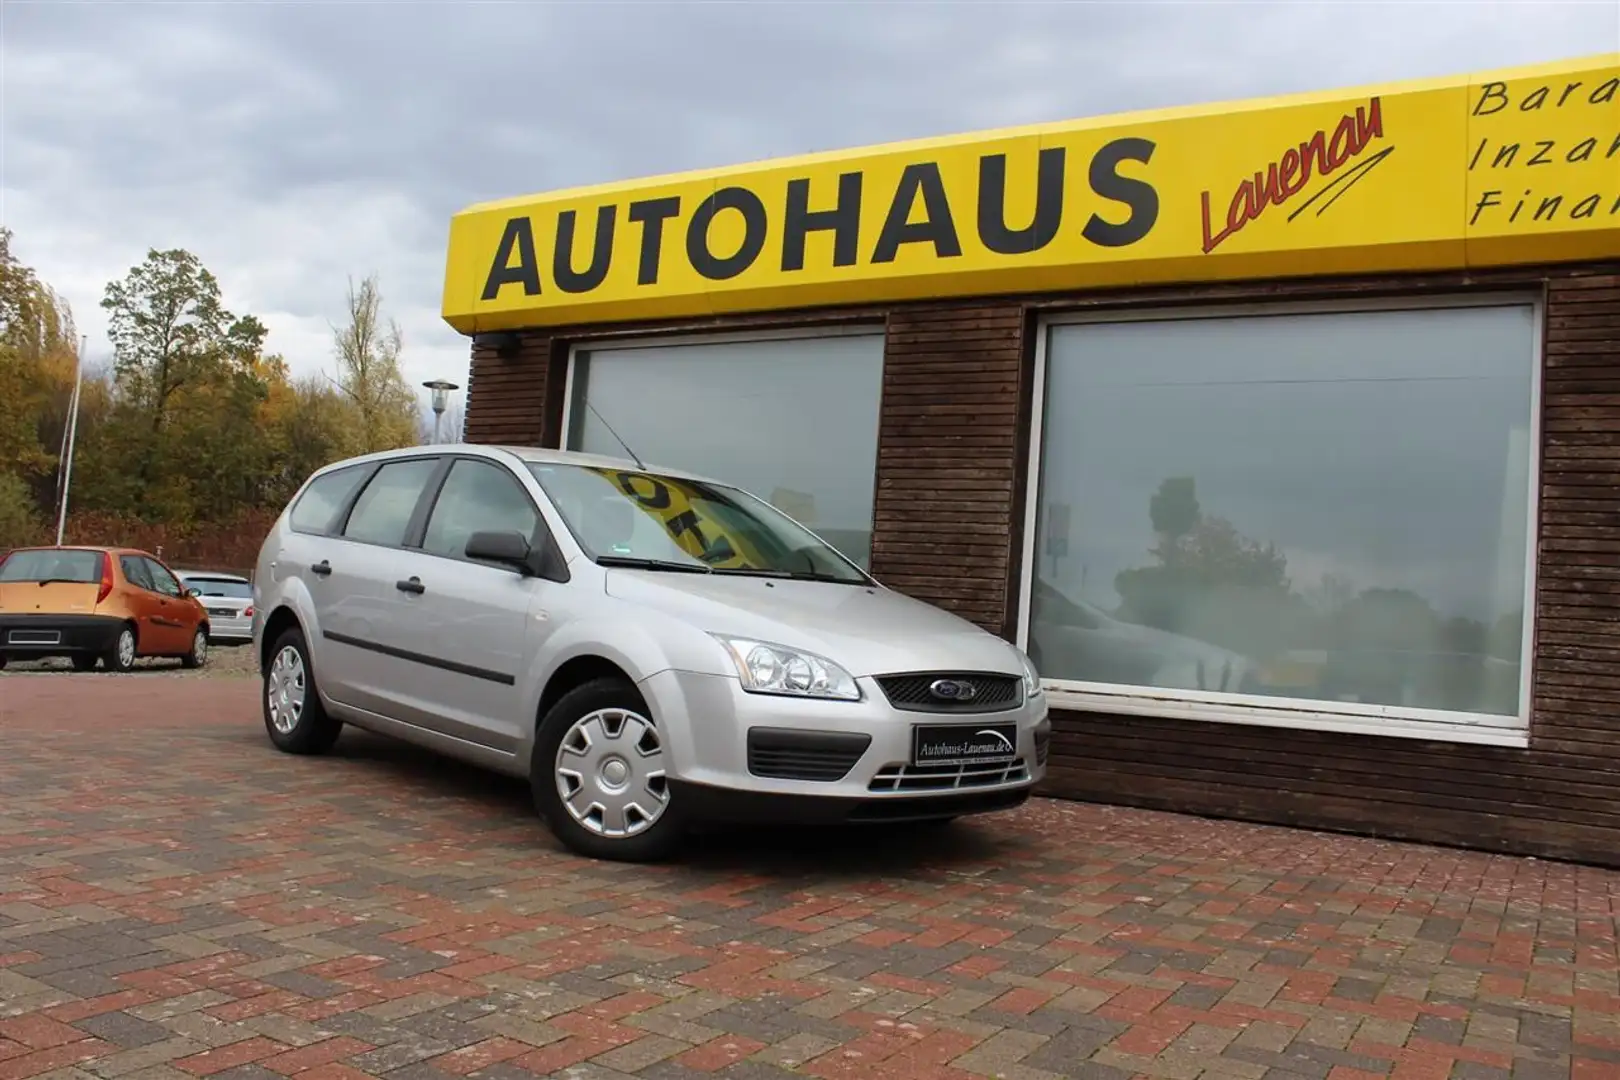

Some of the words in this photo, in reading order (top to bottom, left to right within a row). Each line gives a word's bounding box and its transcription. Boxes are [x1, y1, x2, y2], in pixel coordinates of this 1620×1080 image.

[1472, 78, 1620, 116] Bara
[481, 137, 1160, 300] AUTOHAUS
[1201, 96, 1384, 254] Lauenau
